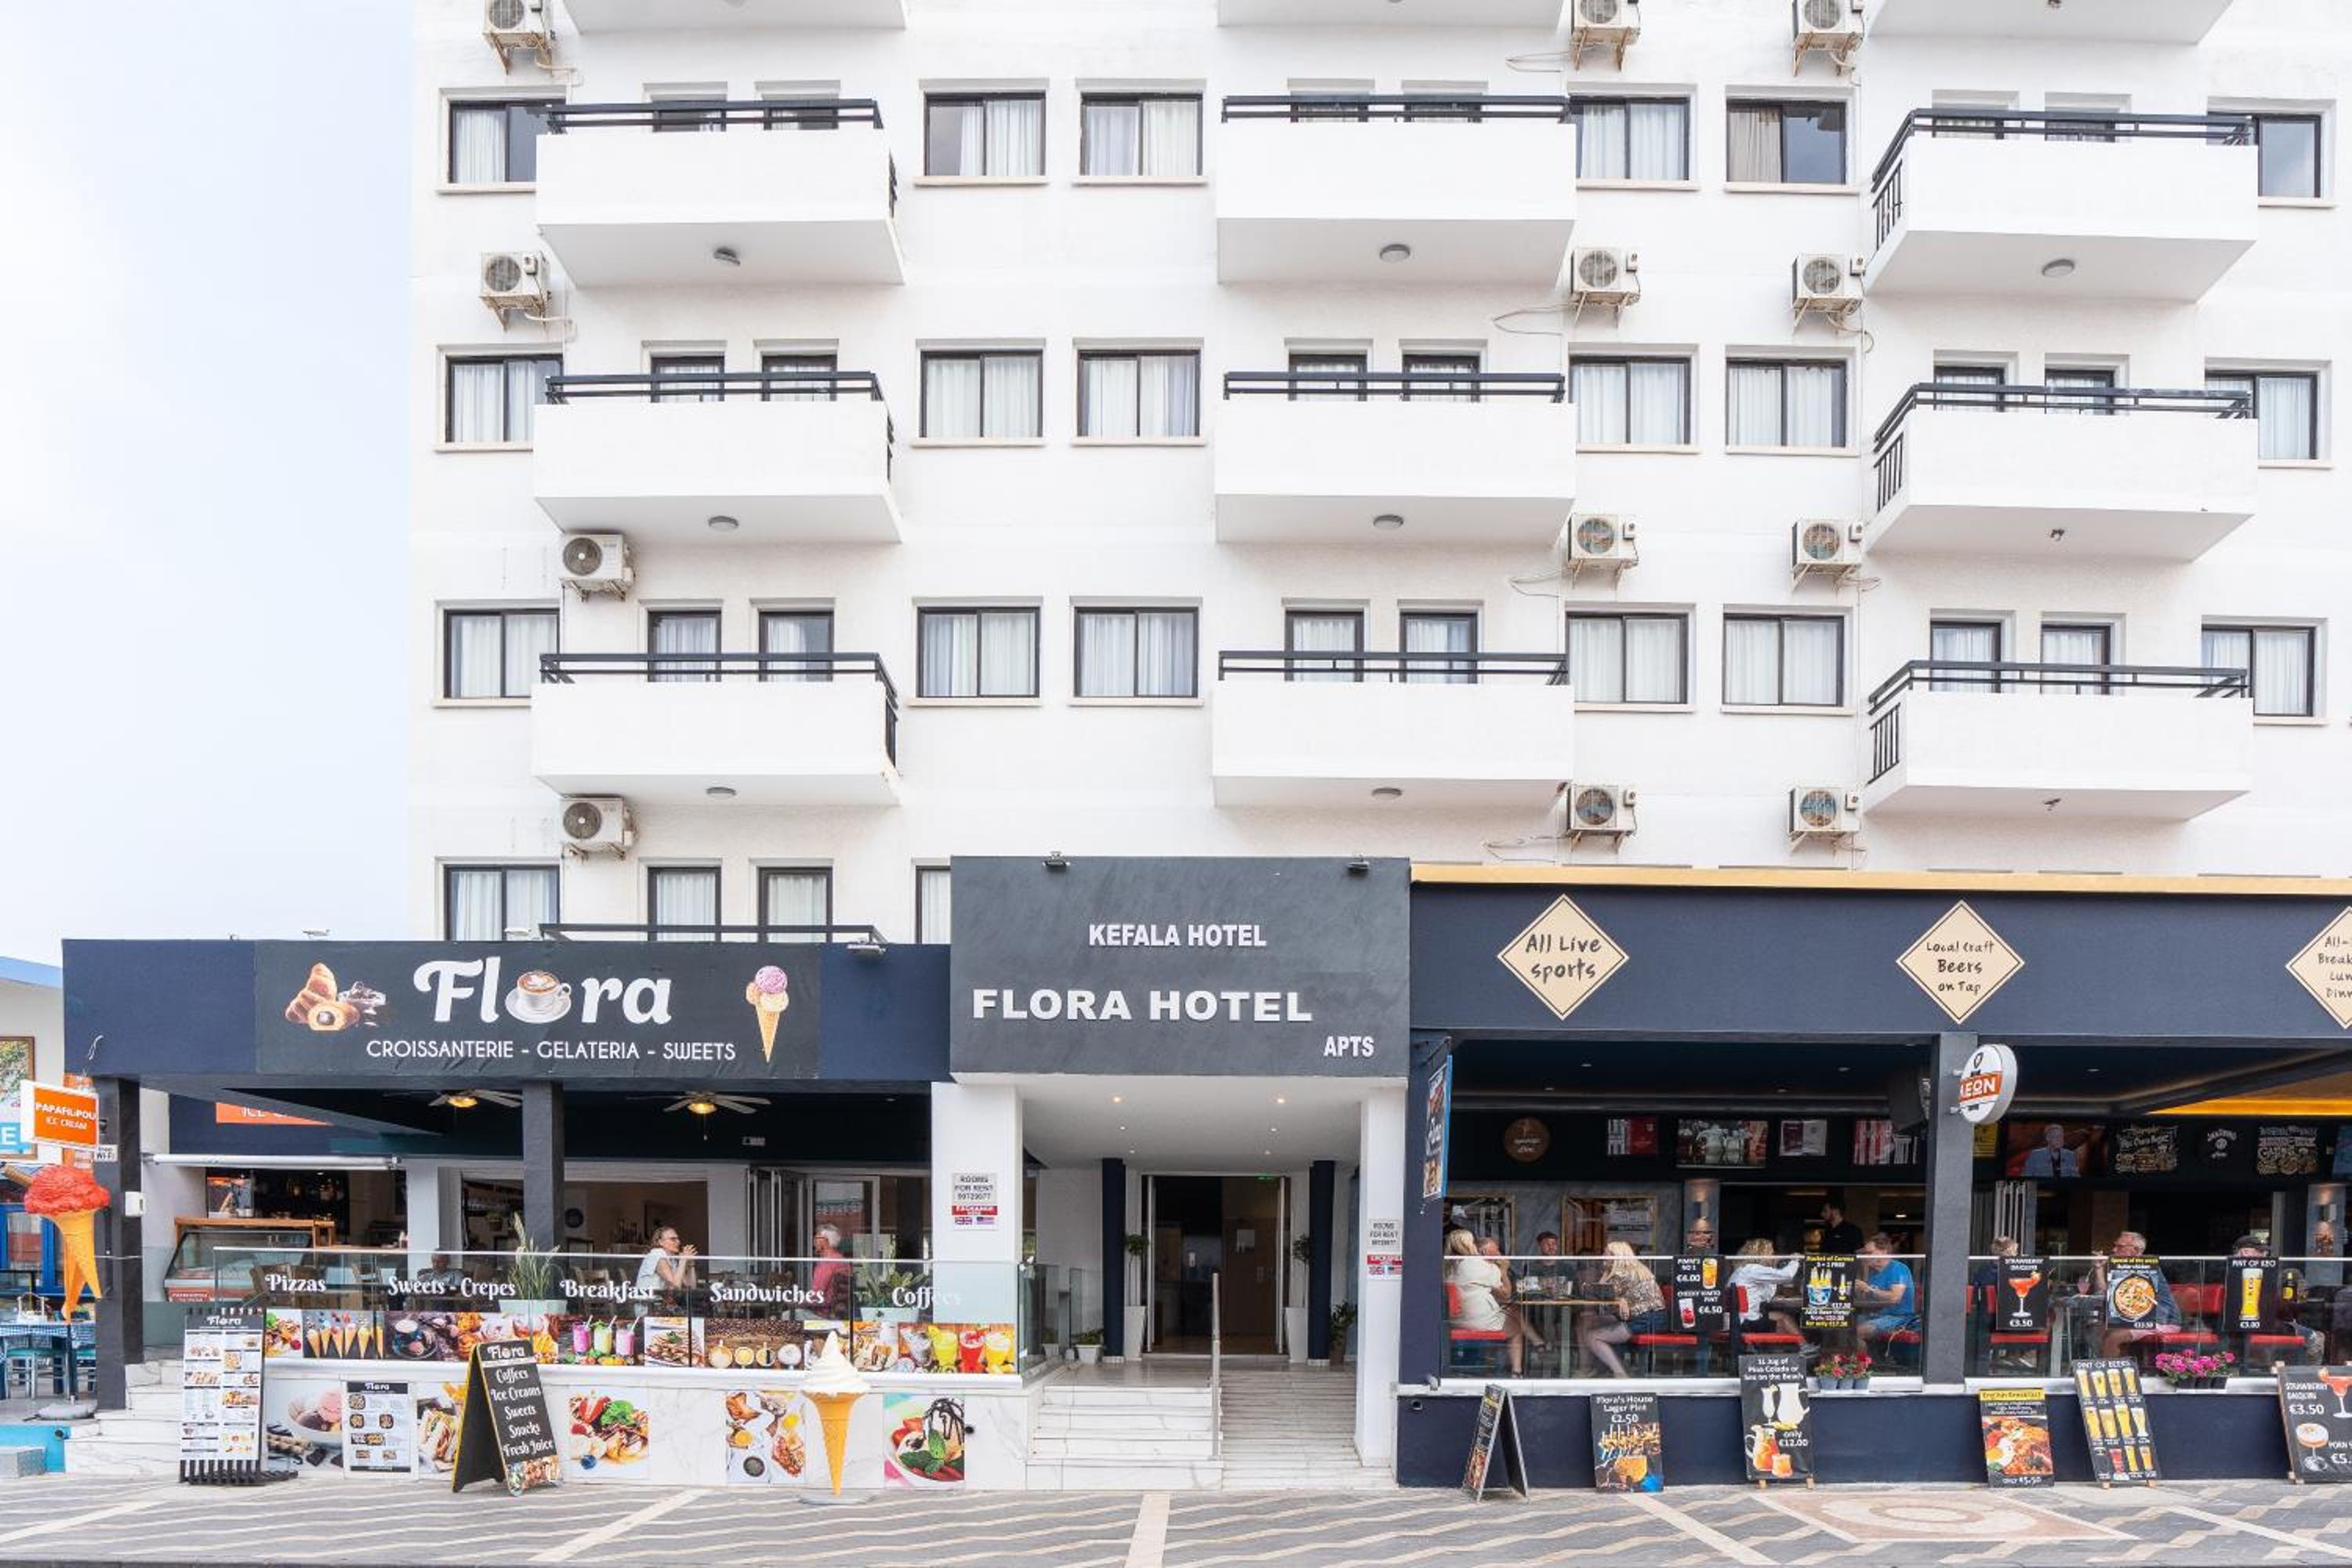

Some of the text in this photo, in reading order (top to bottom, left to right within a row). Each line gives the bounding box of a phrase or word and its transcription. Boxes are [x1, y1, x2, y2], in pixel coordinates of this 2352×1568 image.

[1089, 924, 1267, 946] KEFALA HOTEL
[1526, 934, 1601, 953] All Live
[1926, 941, 1994, 953] Local Craft
[1530, 958, 1596, 984] sports
[1937, 959, 1982, 973] Beers
[1958, 982, 1981, 995] Tap
[973, 989, 1313, 1022] FLORA HOTEL
[366, 1040, 514, 1058] CROISSANTERIE
[537, 1040, 641, 1060] GELATERIA
[663, 1042, 736, 1061] SWEETS
[1324, 1036, 1374, 1057] APTS
[45, 1116, 88, 1130] ICE CREAM
[265, 1273, 327, 1292] Pizzas
[388, 1276, 445, 1295] Sweets
[460, 1277, 516, 1300] Crepes
[559, 1279, 655, 1304] Breakfast
[710, 1282, 825, 1304] Sandwiches
[1699, 1305, 1722, 1314] €4.50
[495, 1368, 529, 1383] Coffees
[491, 1387, 541, 1402] Ice Creams
[504, 1405, 536, 1420] Sweets
[2288, 1404, 2325, 1415] €3.50
[1611, 1414, 1639, 1424] €2.50
[509, 1422, 540, 1438] Snacks
[503, 1439, 554, 1457] Fresh Juice
[1779, 1439, 1809, 1447] €12.00
